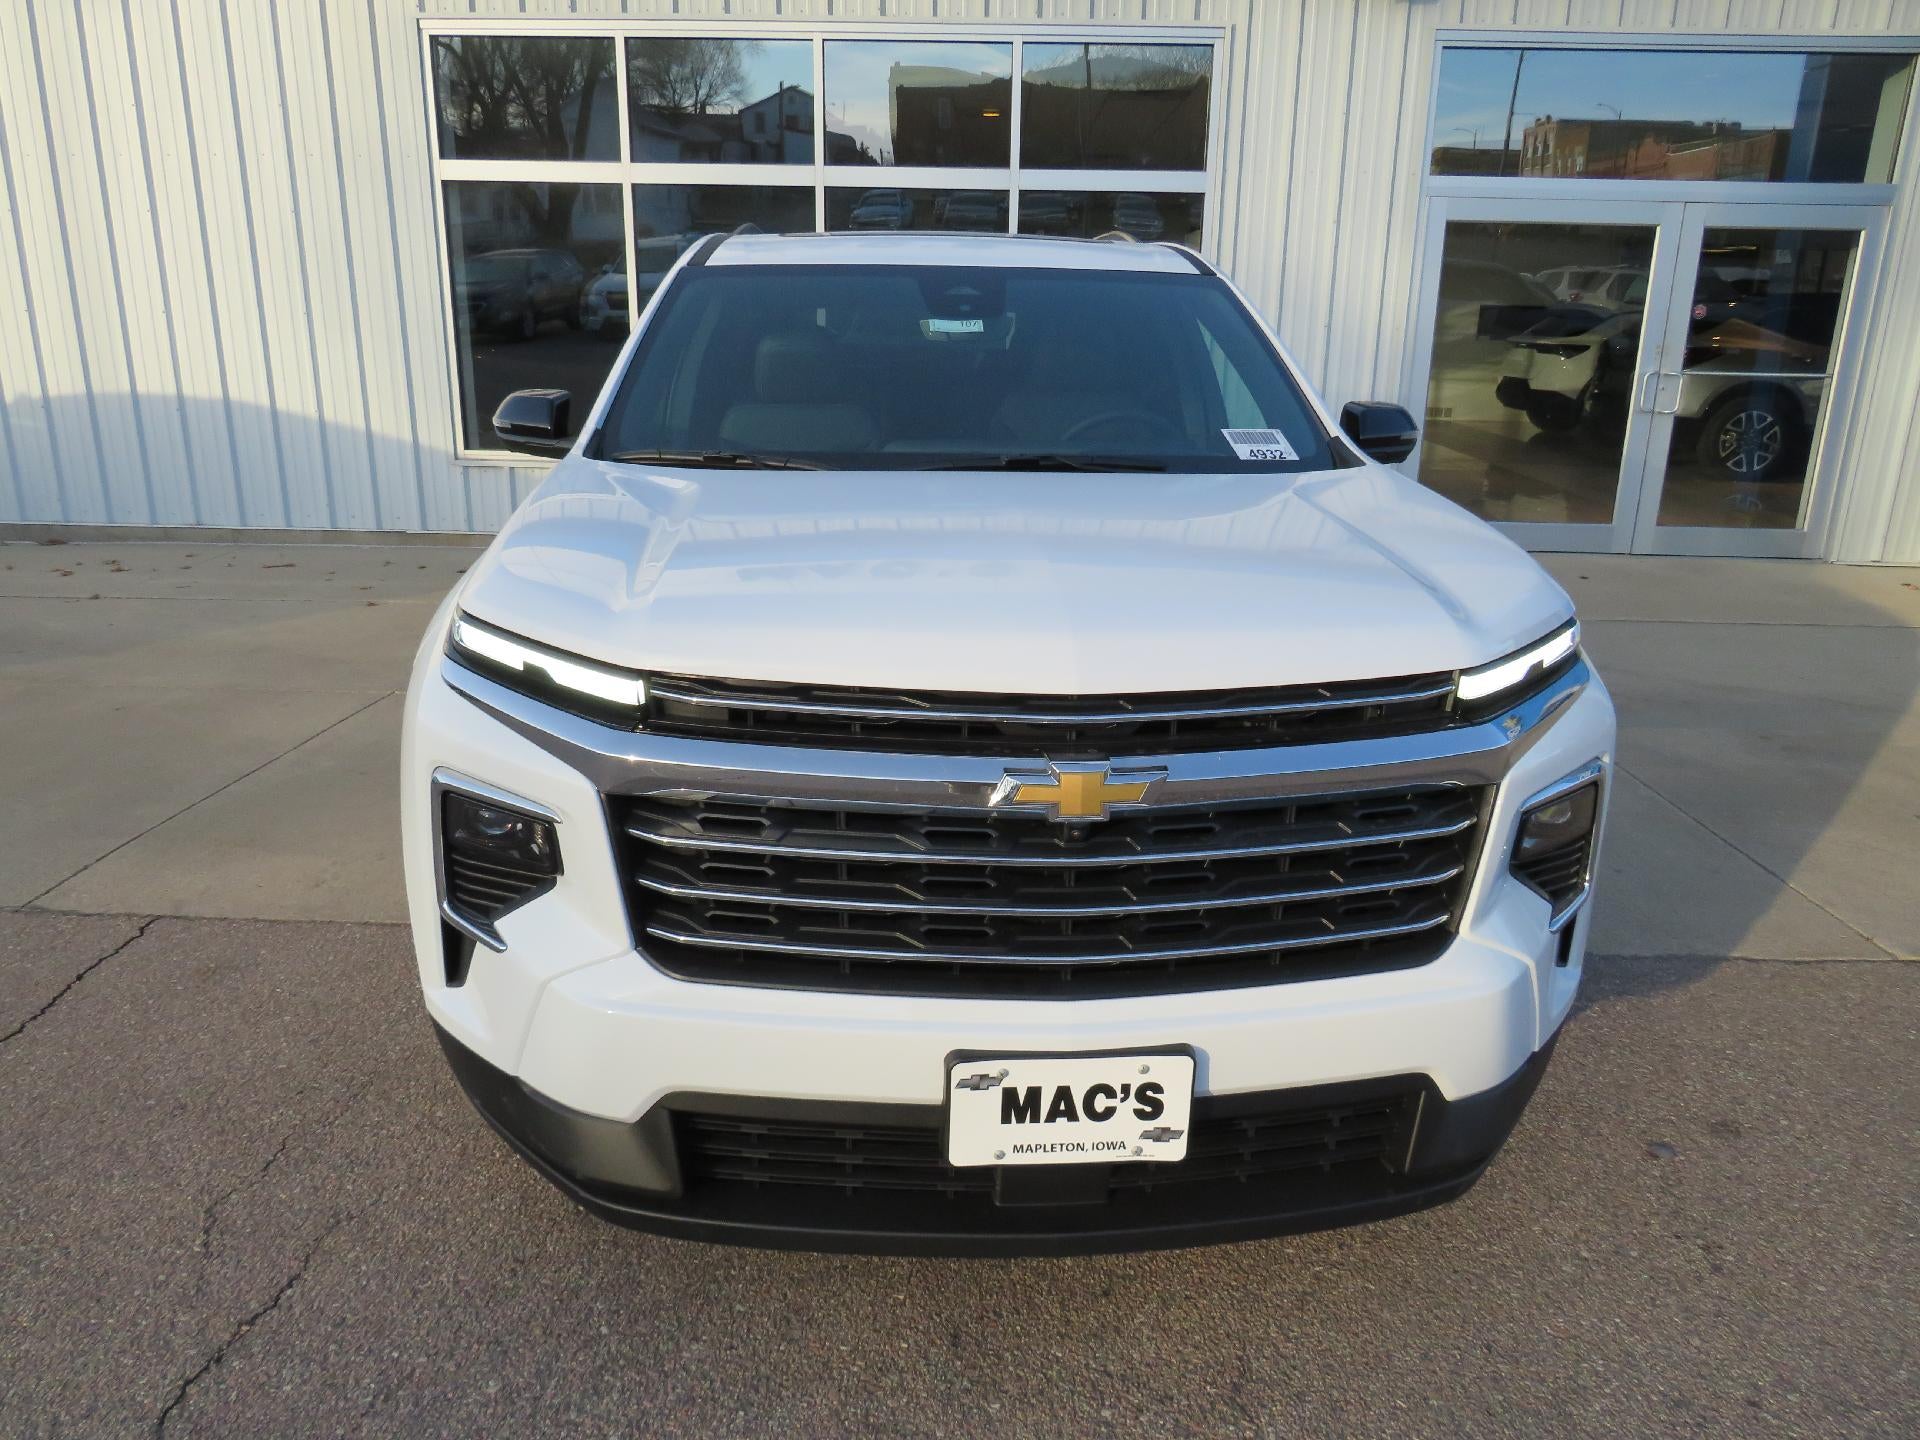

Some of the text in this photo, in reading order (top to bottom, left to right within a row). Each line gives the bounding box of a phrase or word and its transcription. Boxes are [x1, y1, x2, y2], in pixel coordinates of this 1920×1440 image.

[1249, 449, 1287, 460] 4932
[1000, 1082, 1165, 1125] MAC'S
[1012, 1140, 1127, 1154] MAPLETON, IOWA
